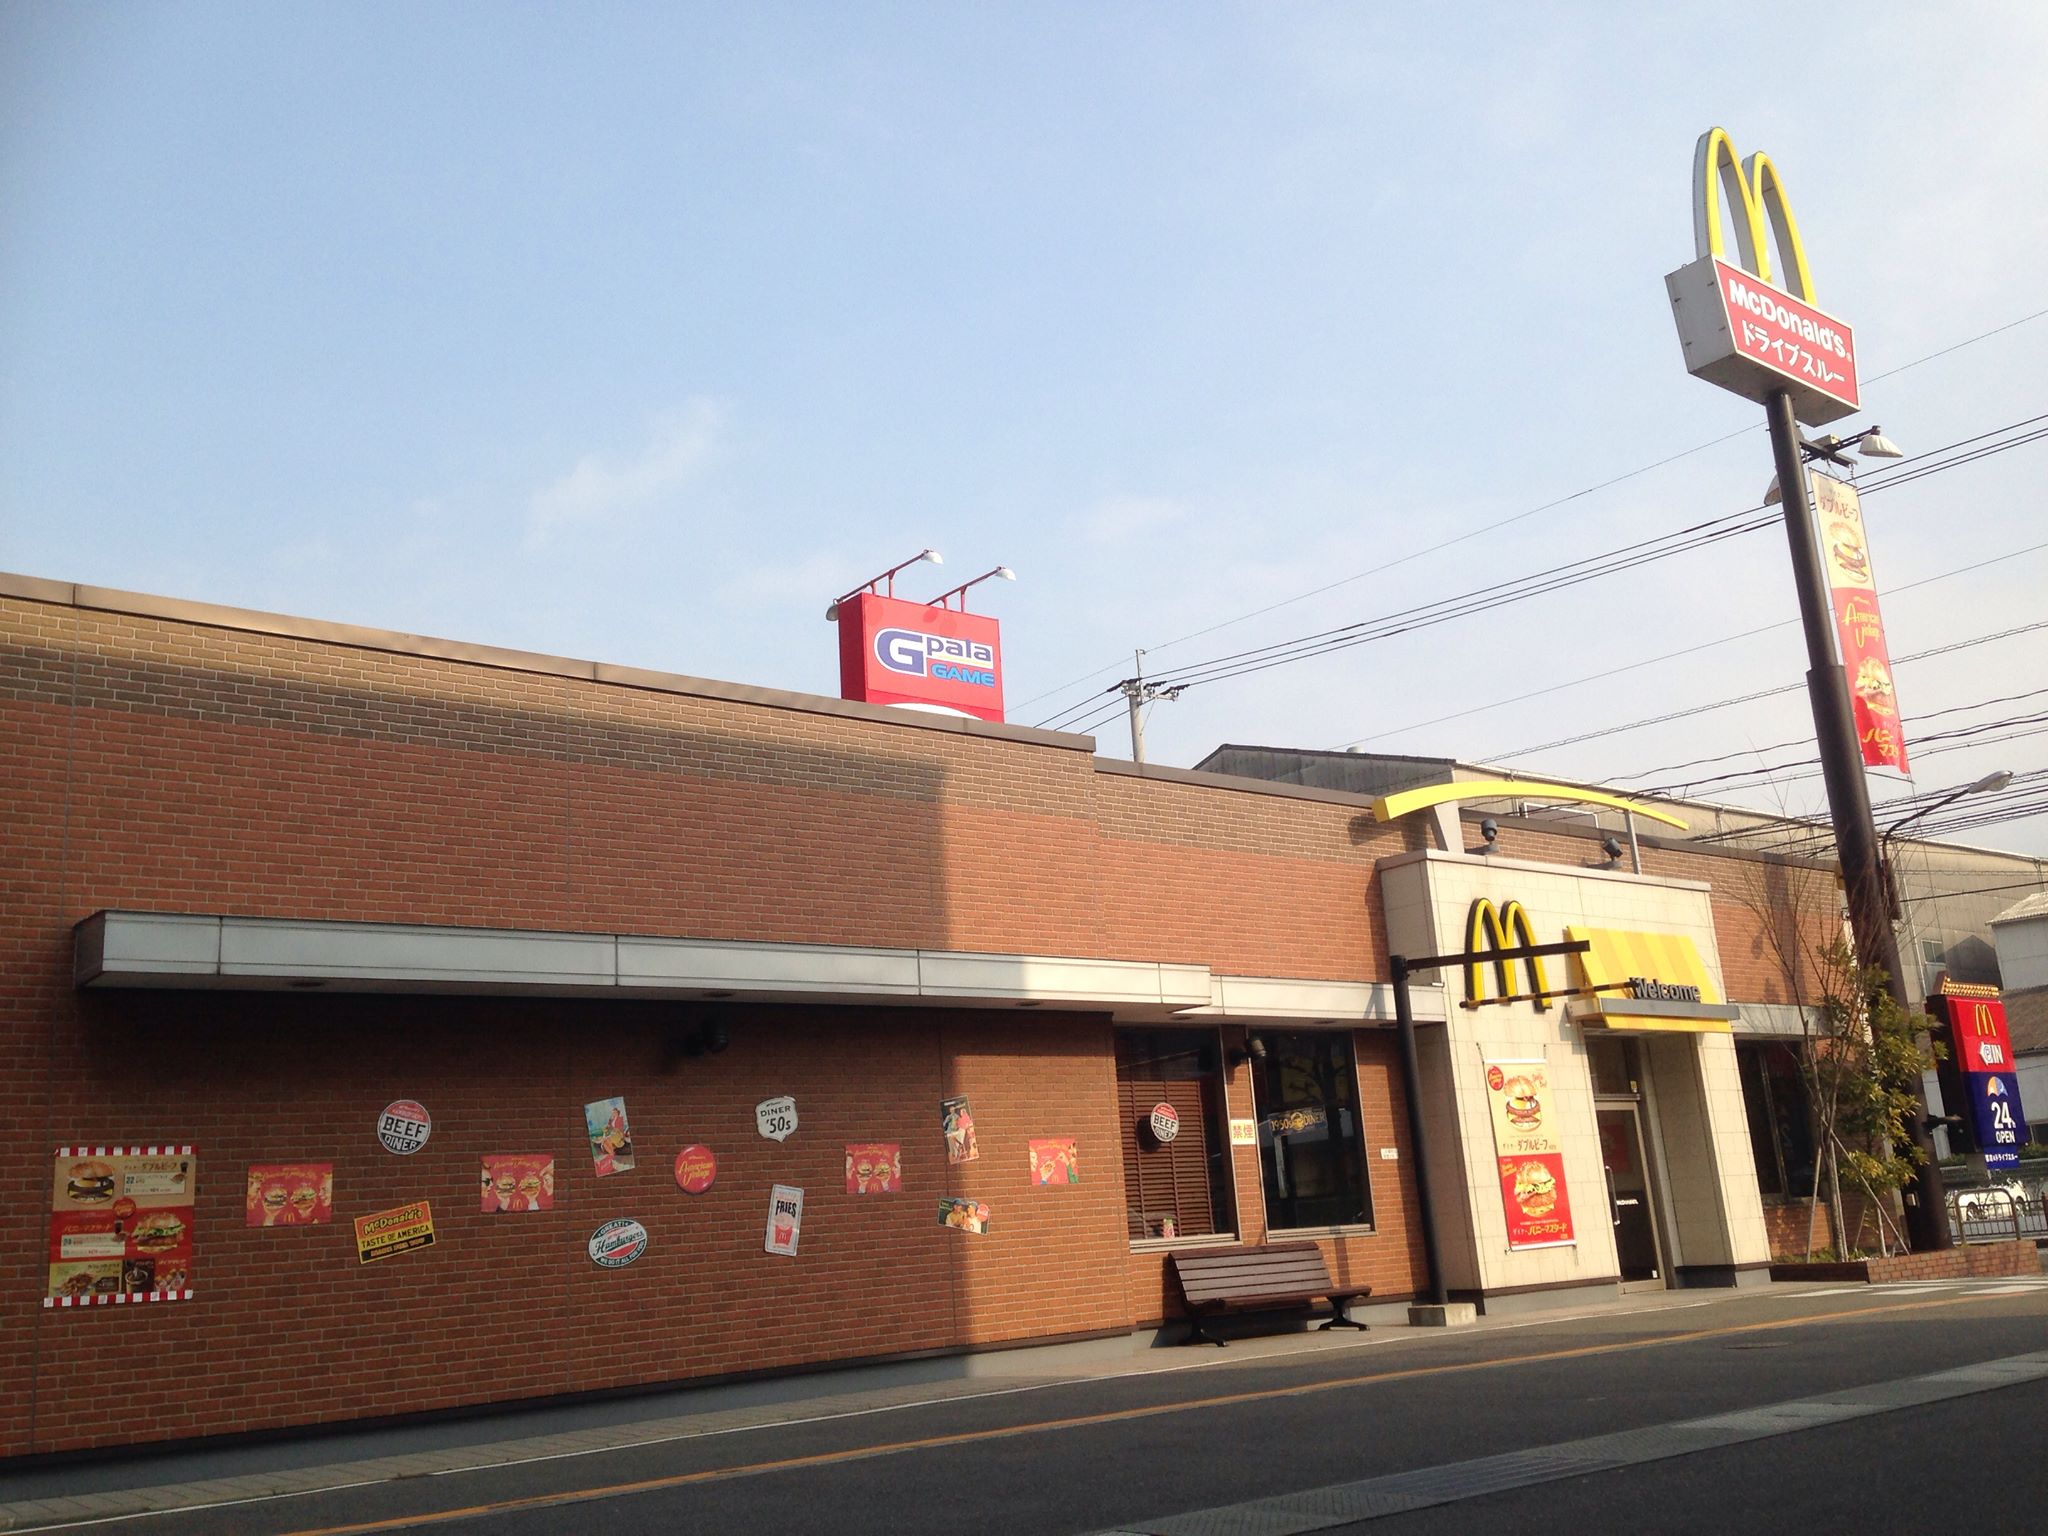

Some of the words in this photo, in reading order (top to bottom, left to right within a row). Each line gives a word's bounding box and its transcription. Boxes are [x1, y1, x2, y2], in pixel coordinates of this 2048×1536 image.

[1729, 279, 1847, 358] McDonald's
[1742, 319, 1845, 382] ドライブスルー
[931, 662, 995, 688] GAME
[1629, 977, 1701, 1003] Welcome
[760, 1105, 791, 1117] DINER
[383, 1116, 426, 1137] BEEF
[766, 1116, 791, 1134] '50s
[1154, 1114, 1176, 1130] BEEF
[384, 1134, 418, 1151] DINER
[1995, 1131, 2016, 1144] OPEN
[776, 1200, 797, 1219] FRIES
[363, 1208, 423, 1236] McDonald's
[361, 1235, 386, 1249] TASTE
[397, 1224, 430, 1240] AMERICA
